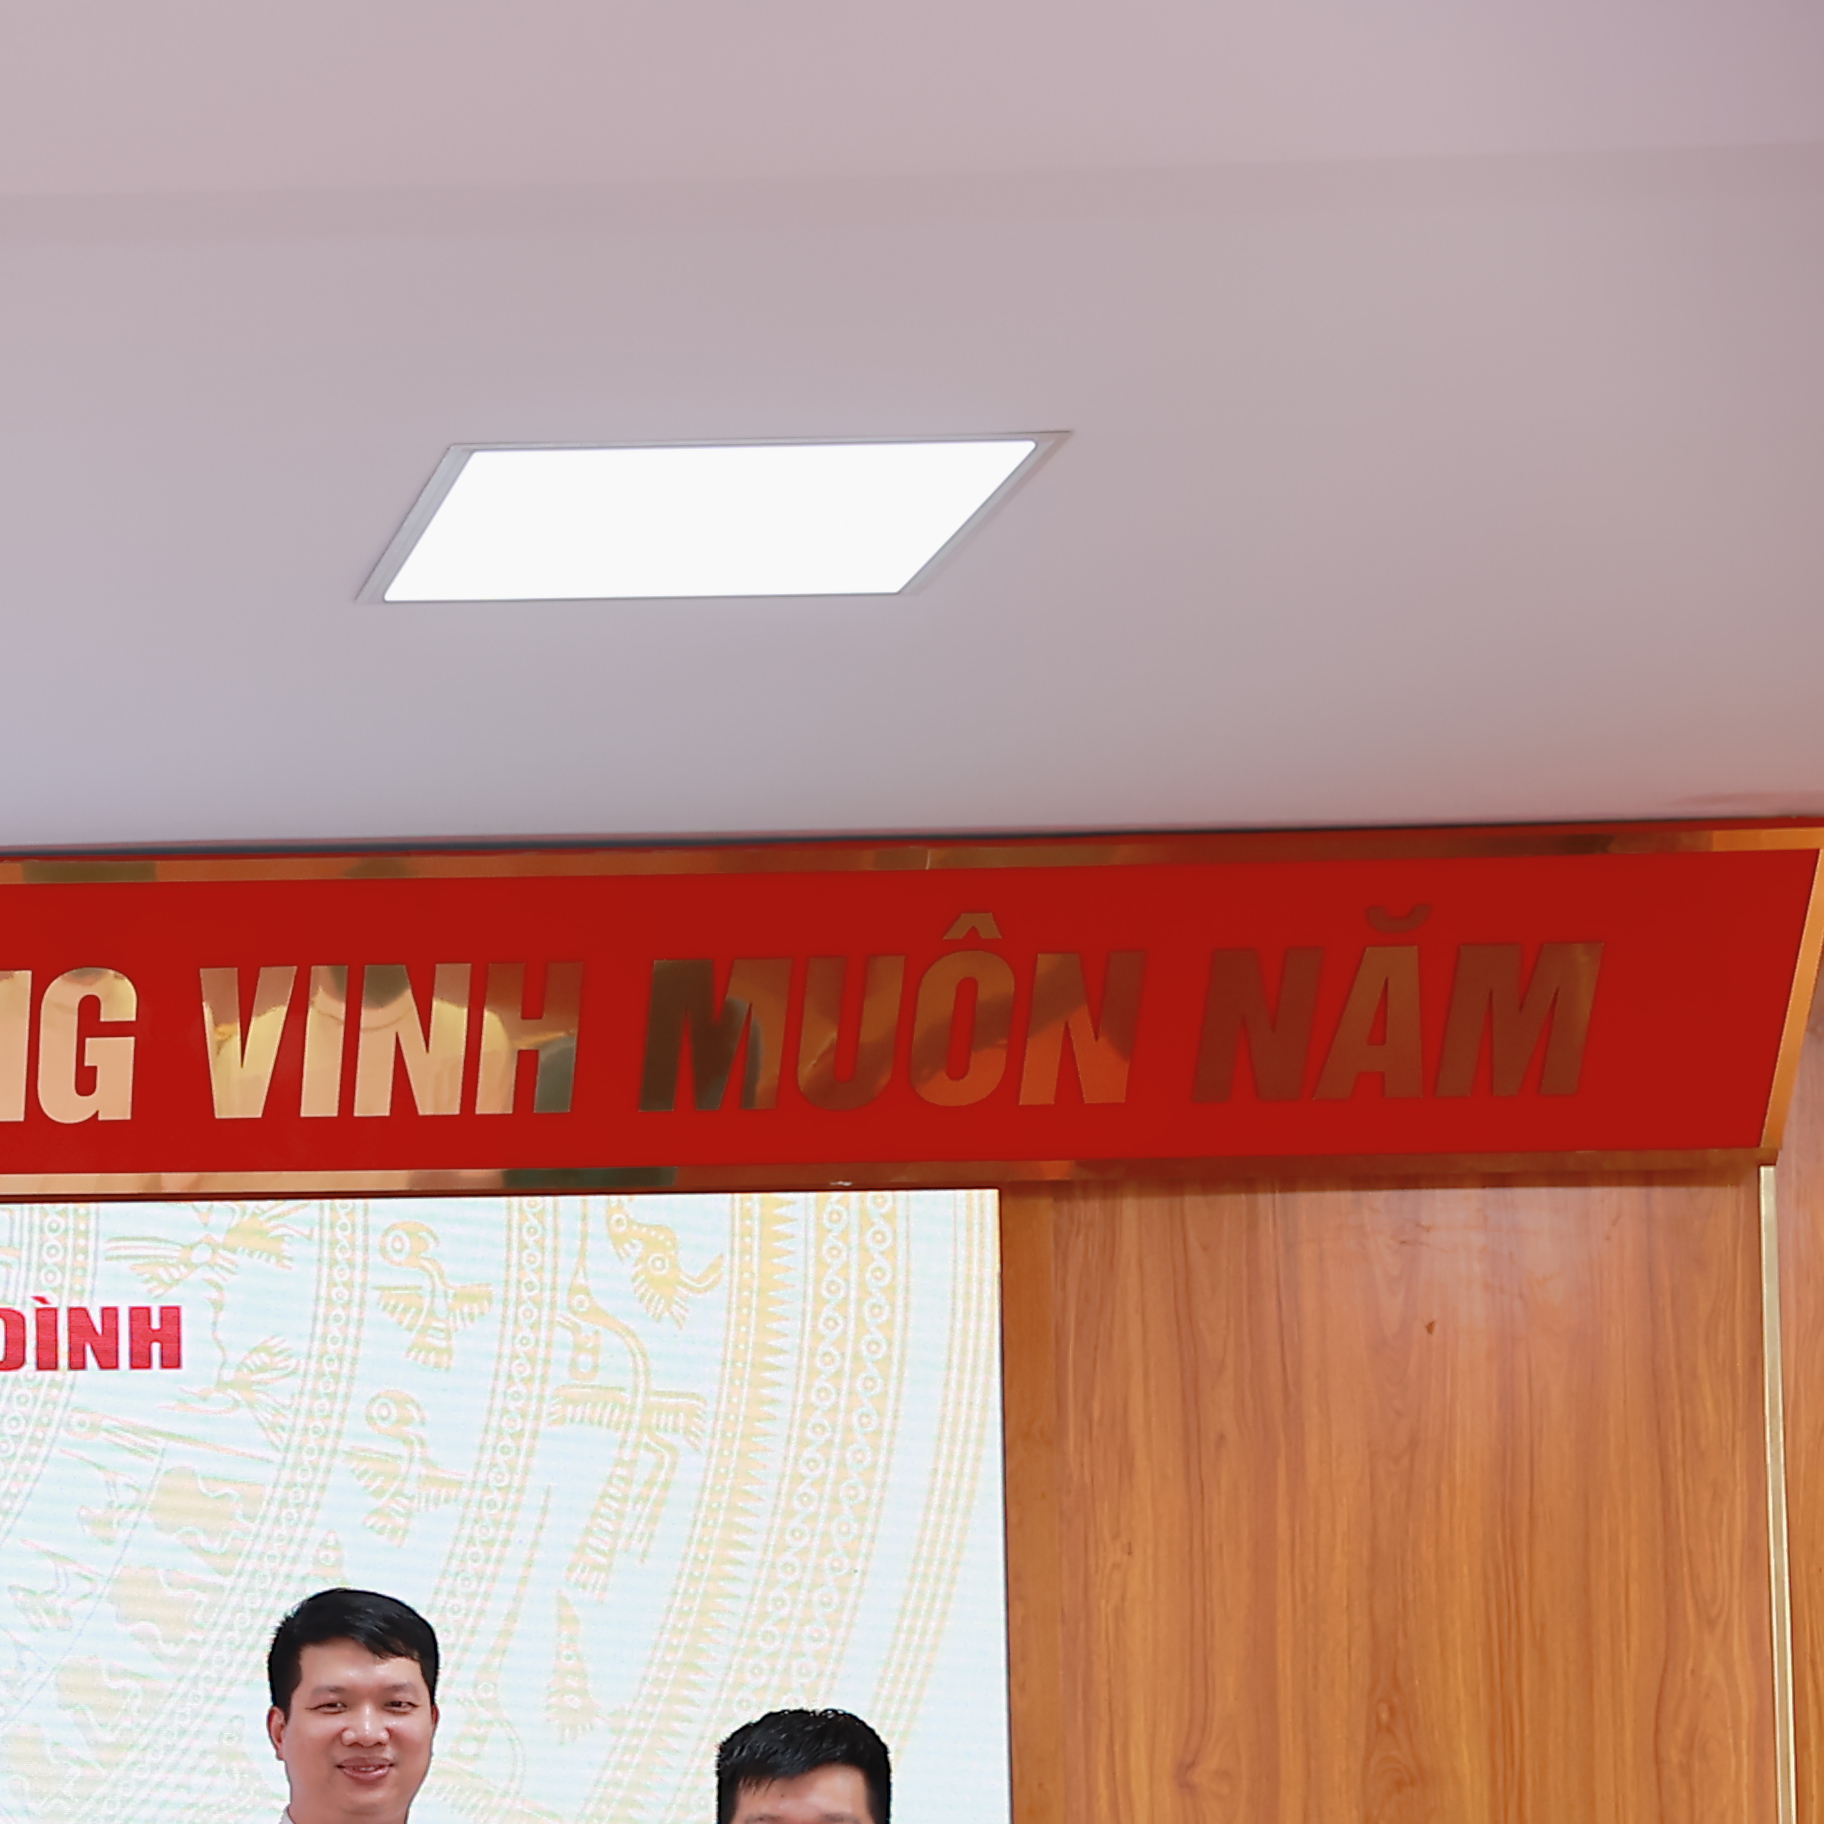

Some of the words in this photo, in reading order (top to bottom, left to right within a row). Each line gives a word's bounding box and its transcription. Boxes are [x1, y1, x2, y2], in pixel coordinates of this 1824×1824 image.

[199, 961, 583, 1119] VINH
[638, 912, 1147, 1112] MUÔN
[1190, 904, 1604, 1103] NĂM
